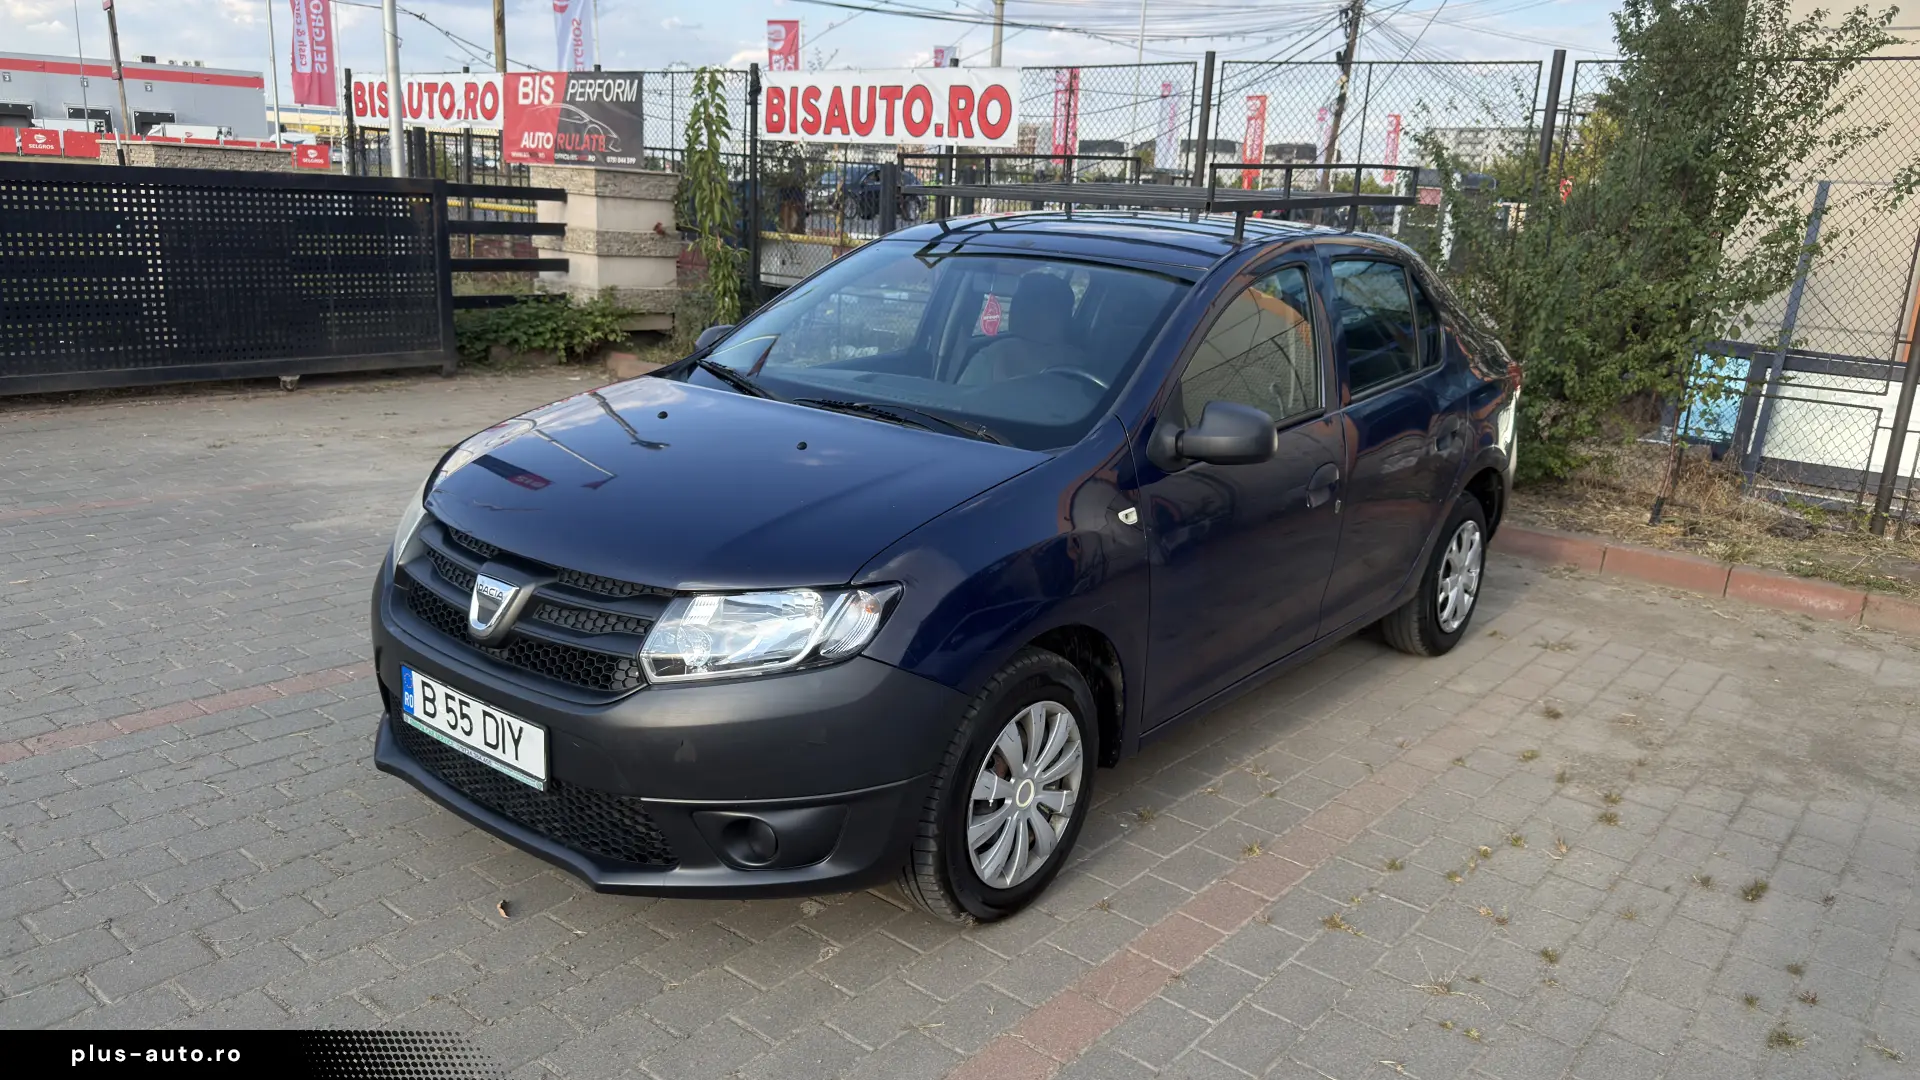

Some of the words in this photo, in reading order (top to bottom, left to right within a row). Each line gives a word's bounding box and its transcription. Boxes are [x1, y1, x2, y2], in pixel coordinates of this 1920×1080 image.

[518, 75, 555, 106] BIS
[566, 79, 639, 103] PERFORM
[765, 84, 1013, 140] BISAUTO.RO
[521, 131, 554, 149] AUTO
[556, 133, 607, 152] RULATE
[478, 583, 504, 600] DACIA
[404, 691, 414, 709] RO
[421, 679, 437, 719] B
[444, 692, 474, 737] 55
[482, 709, 524, 761] DIY
